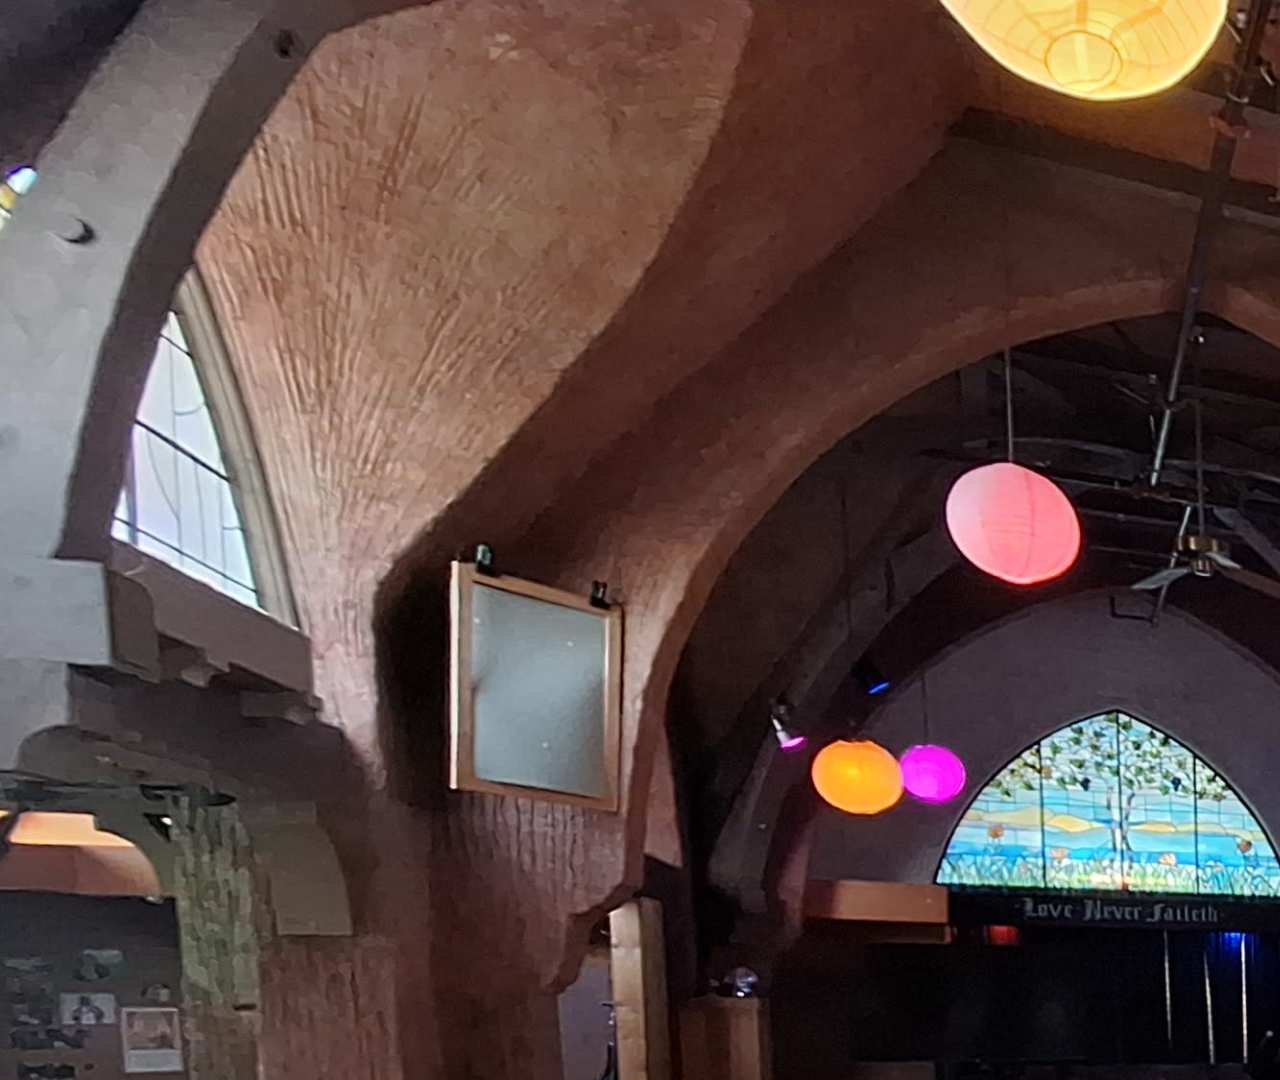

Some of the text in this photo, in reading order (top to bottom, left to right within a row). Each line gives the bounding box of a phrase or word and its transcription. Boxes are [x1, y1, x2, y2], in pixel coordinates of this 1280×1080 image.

[1023, 898, 1219, 922] Love Never Faileth
